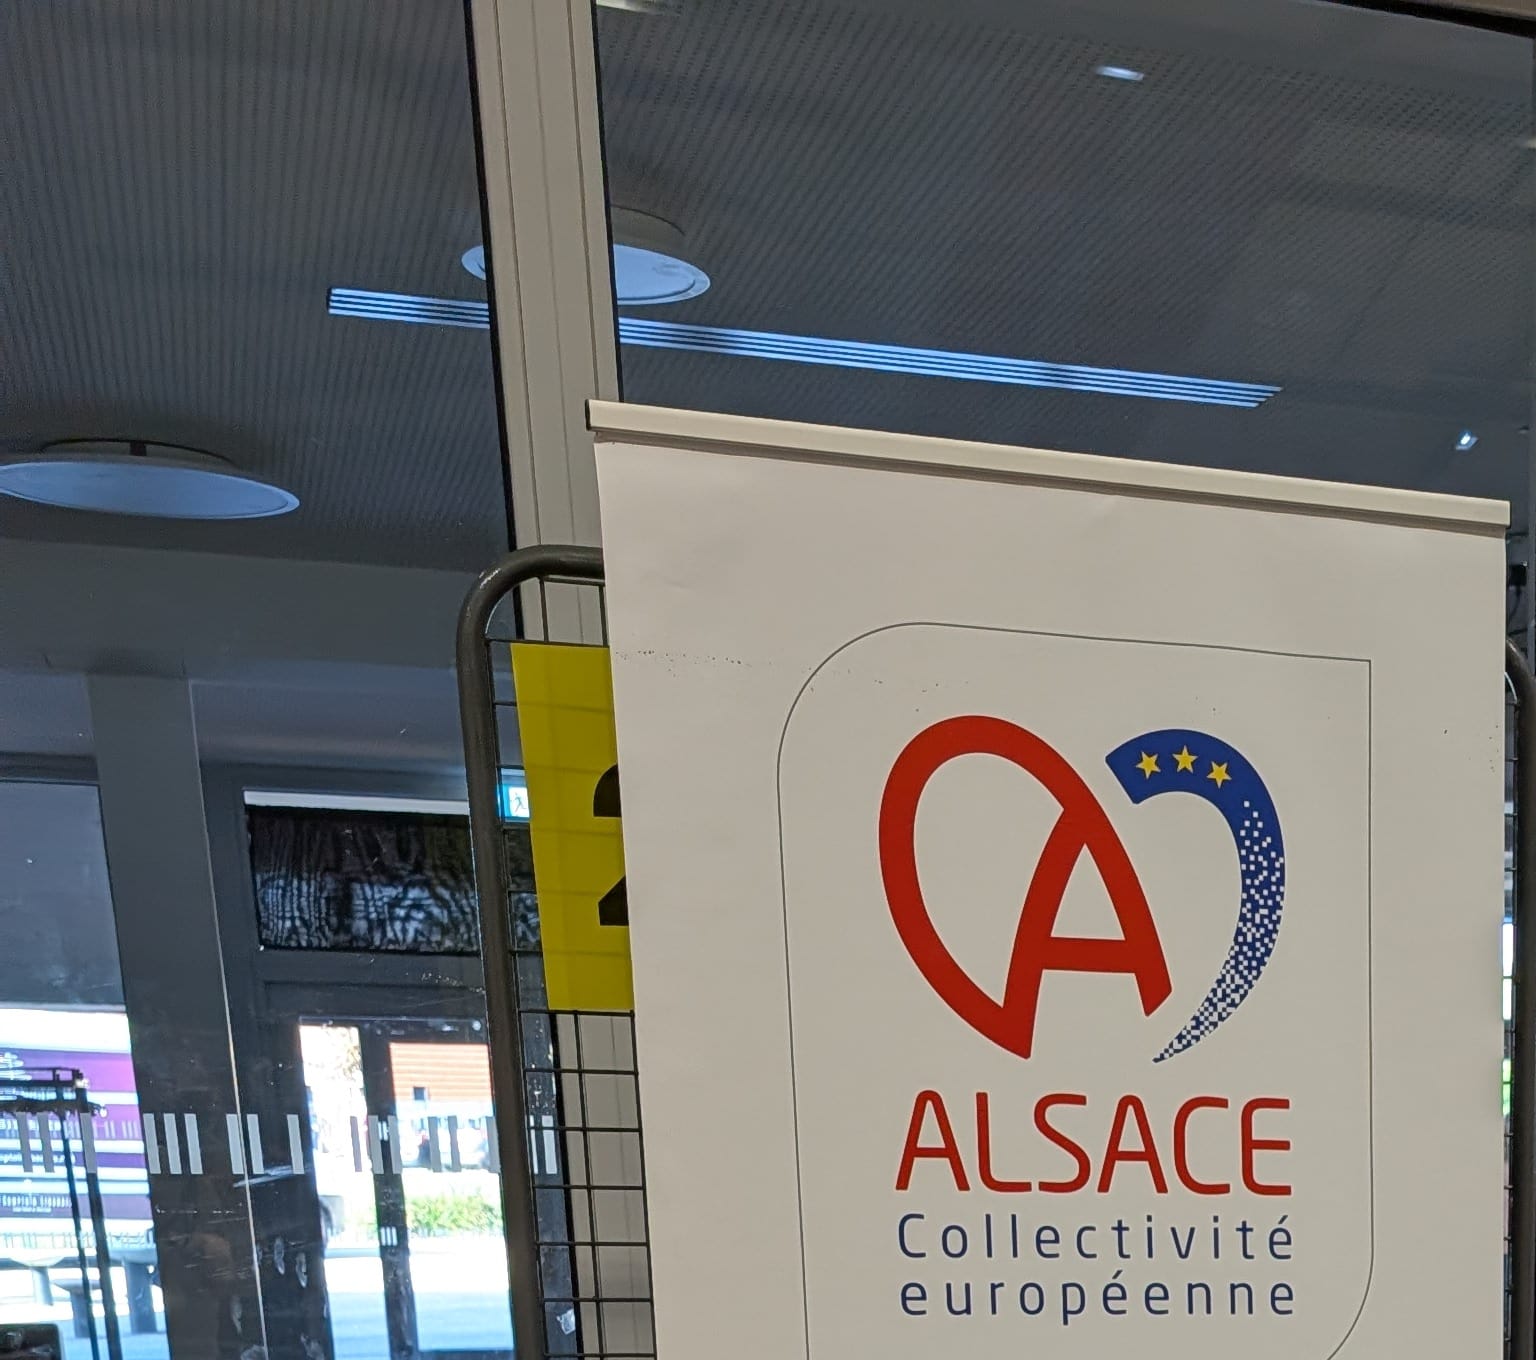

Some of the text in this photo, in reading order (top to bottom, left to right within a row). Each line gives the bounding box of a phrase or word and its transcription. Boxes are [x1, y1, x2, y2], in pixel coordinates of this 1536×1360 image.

[895, 1089, 1293, 1196] ALSACE
[896, 1212, 1295, 1261] Collectivité
[899, 1271, 1296, 1326] européenne
